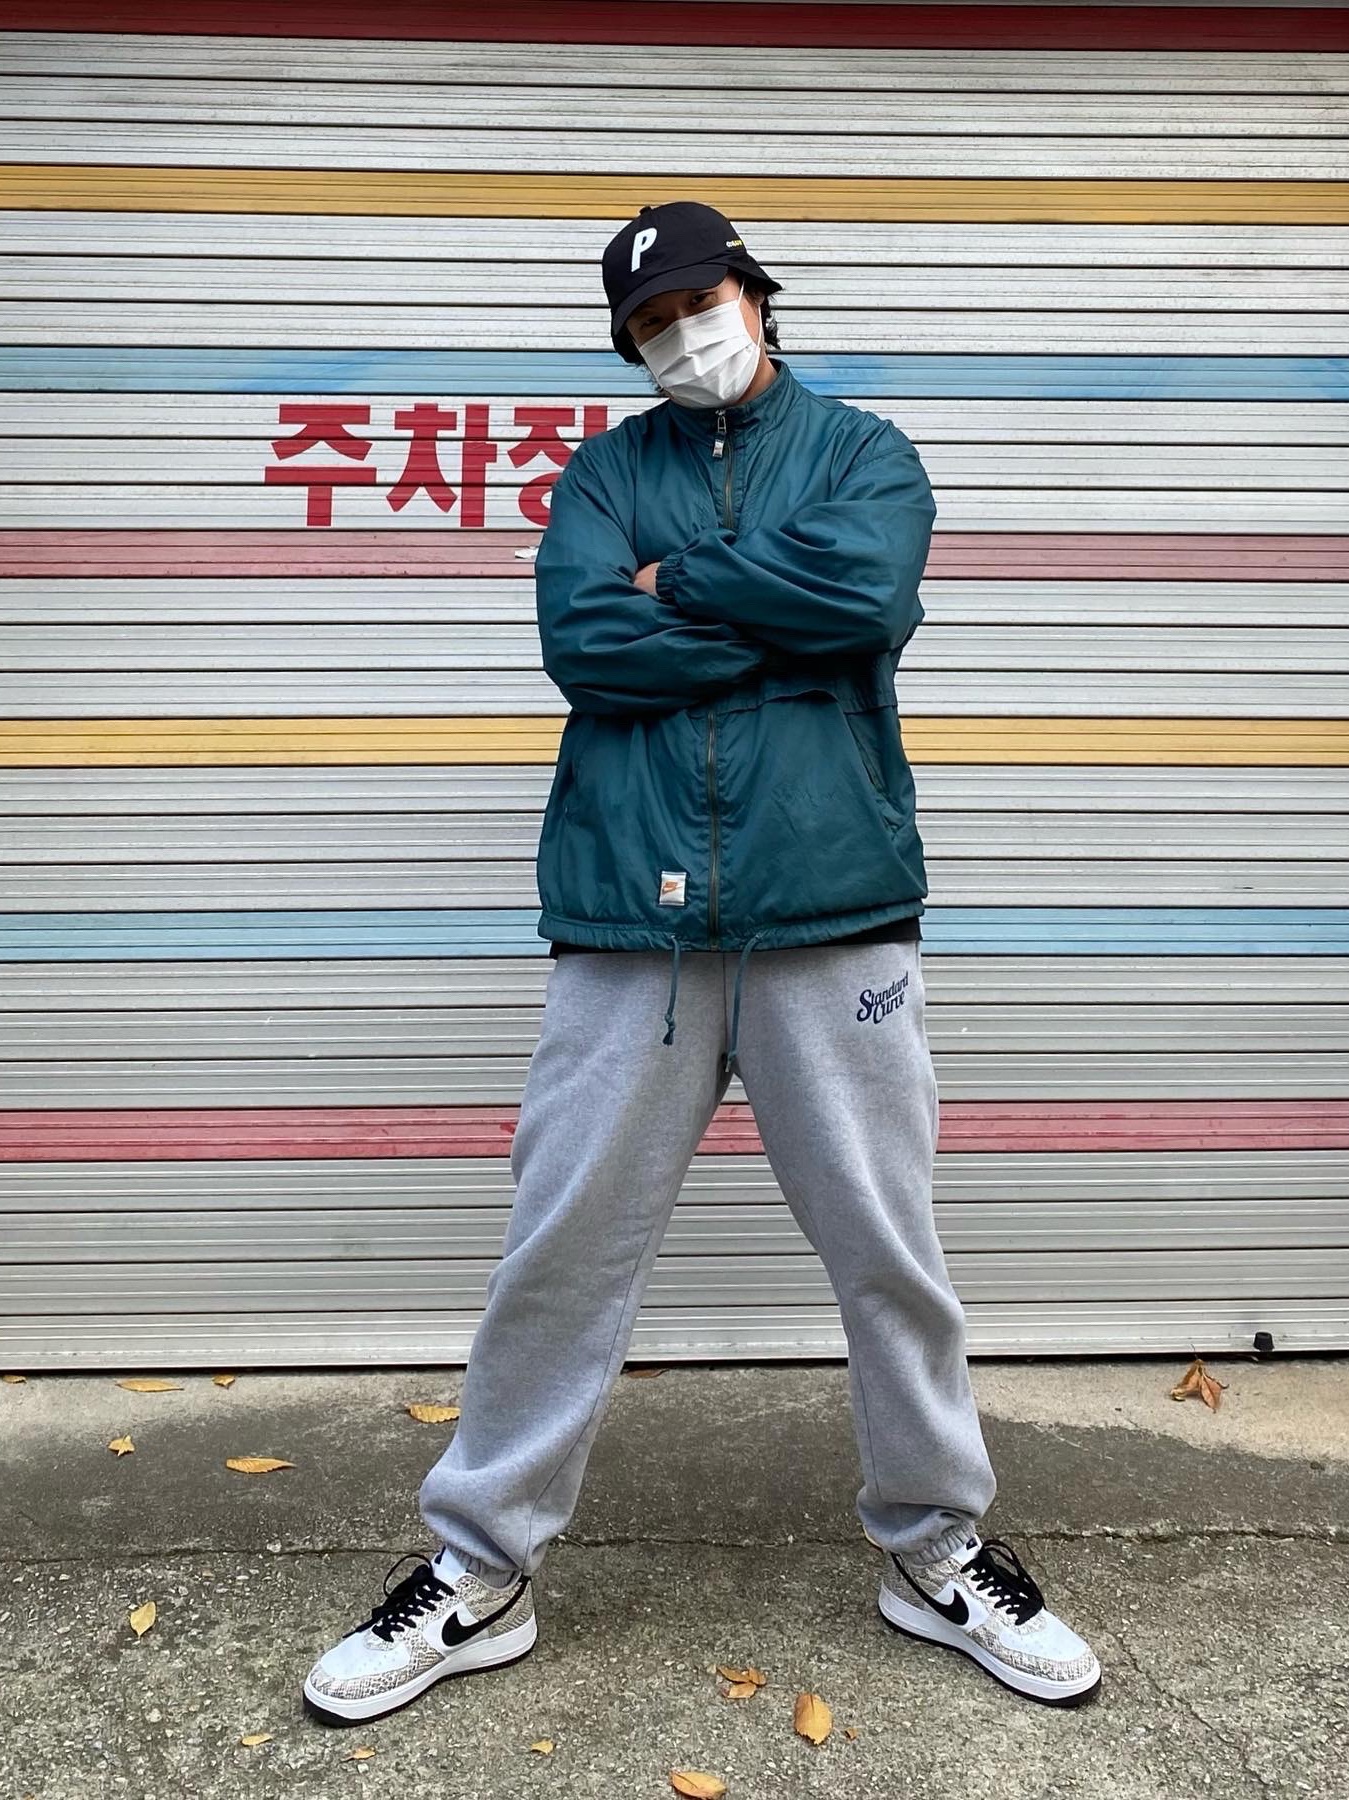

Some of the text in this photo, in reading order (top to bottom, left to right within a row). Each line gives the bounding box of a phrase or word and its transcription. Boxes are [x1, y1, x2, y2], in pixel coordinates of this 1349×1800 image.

[631, 227, 657, 272] P
[857, 971, 909, 1022] Standard
[873, 990, 905, 1024] Curve
